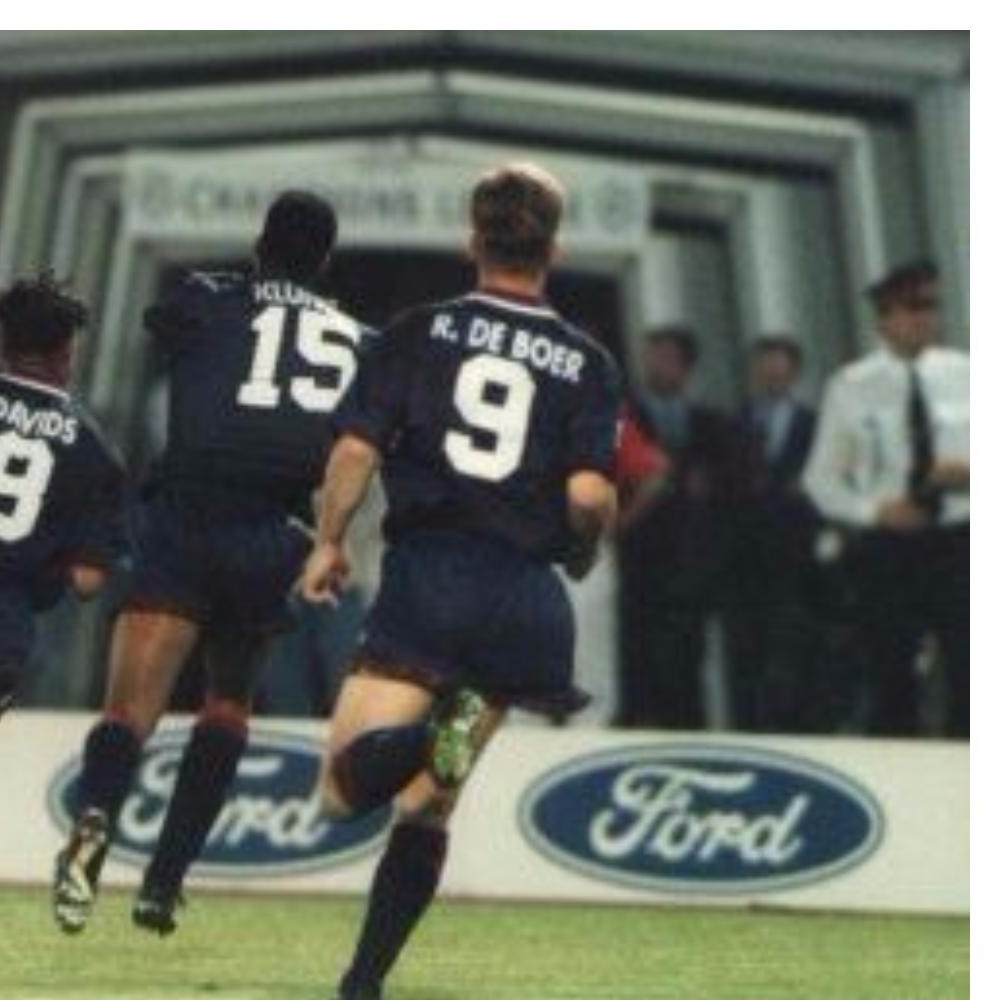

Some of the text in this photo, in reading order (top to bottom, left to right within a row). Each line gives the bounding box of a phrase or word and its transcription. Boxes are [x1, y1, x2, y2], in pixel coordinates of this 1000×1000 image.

[236, 305, 361, 413] 15
[430, 314, 583, 382] R. DE BOER
[442, 353, 537, 483] 9
[589, 758, 805, 866] Ford
